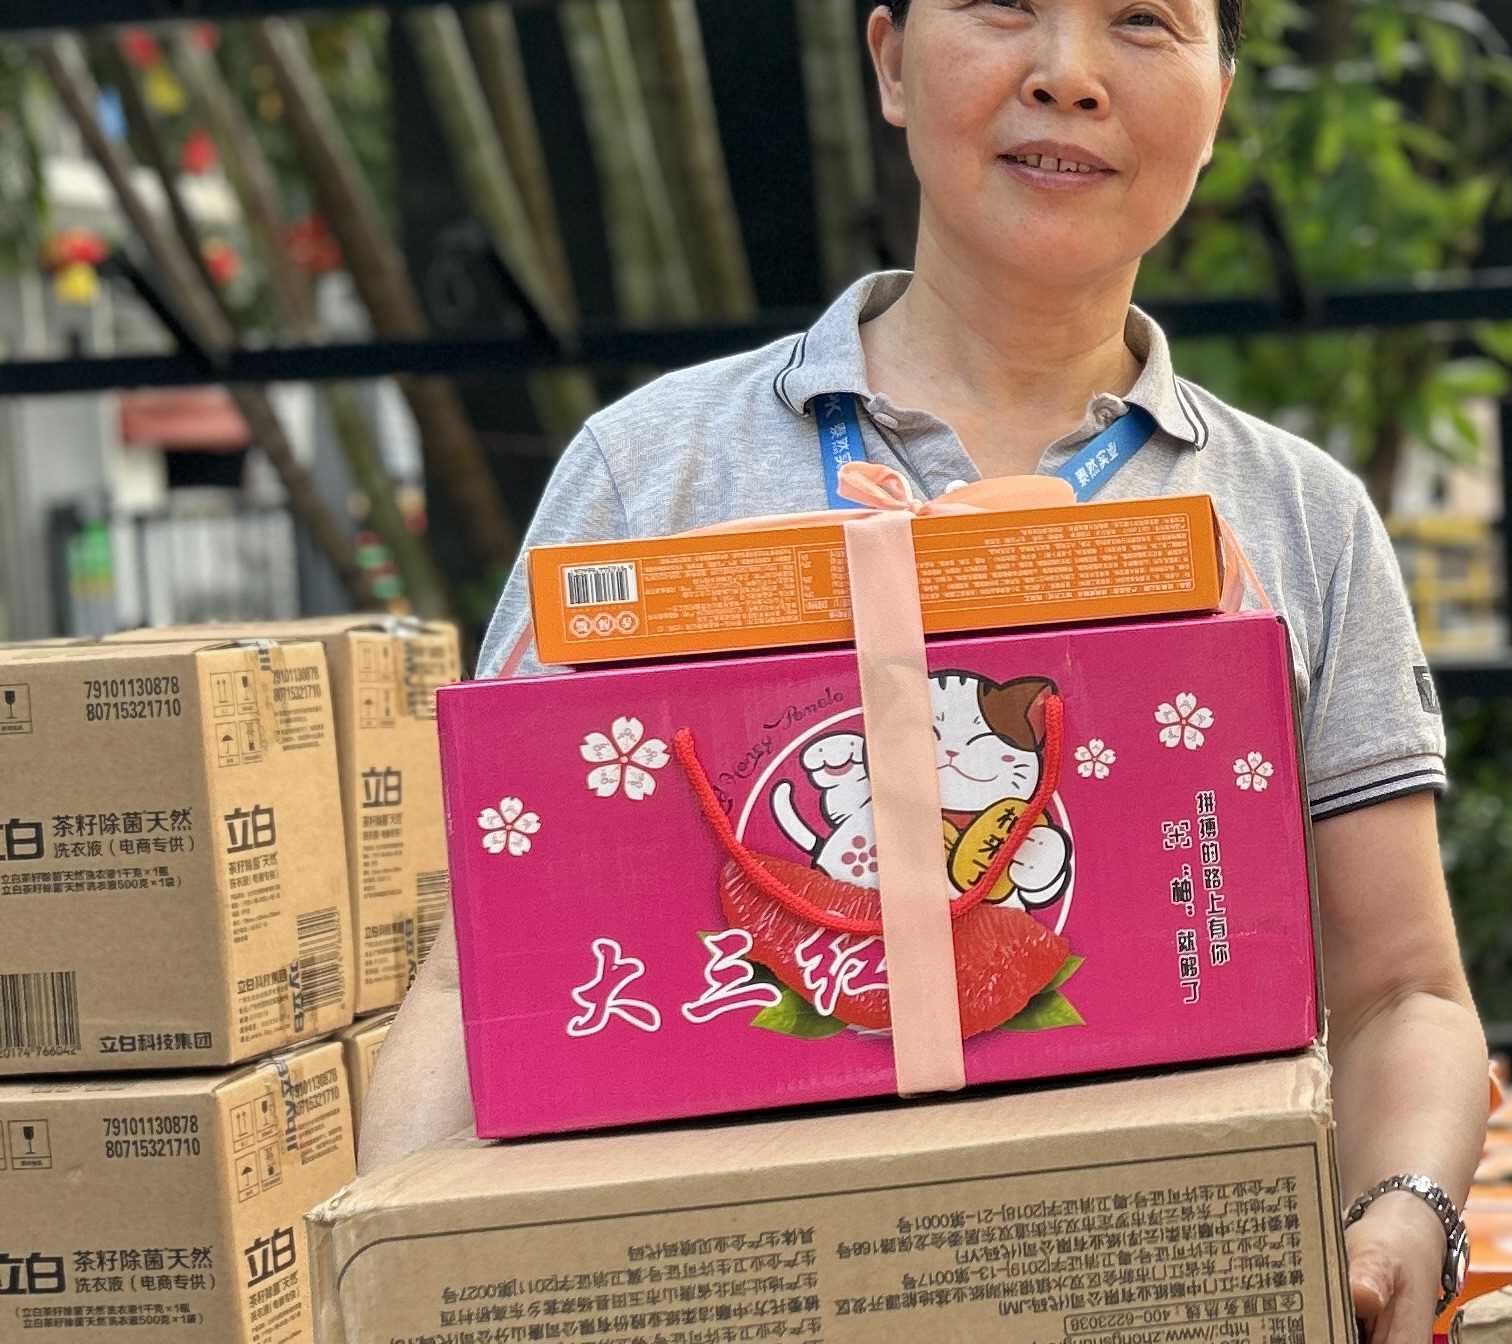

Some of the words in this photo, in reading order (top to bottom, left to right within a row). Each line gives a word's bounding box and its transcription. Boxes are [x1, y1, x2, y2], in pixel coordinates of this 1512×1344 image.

[84, 676, 180, 700] 79101130878
[86, 699, 182, 722] 80715321710
[361, 766, 402, 809] 立白
[0, 818, 45, 862] 白
[224, 804, 276, 855] 立白
[1195, 790, 1231, 967] 拼搏的路上有你
[99, 1032, 213, 1054] 立白科技集团
[103, 1115, 199, 1137] 79101130878
[105, 1136, 201, 1159] 80715321710
[0, 1252, 66, 1295] 立白
[244, 1226, 297, 1288] 立白
